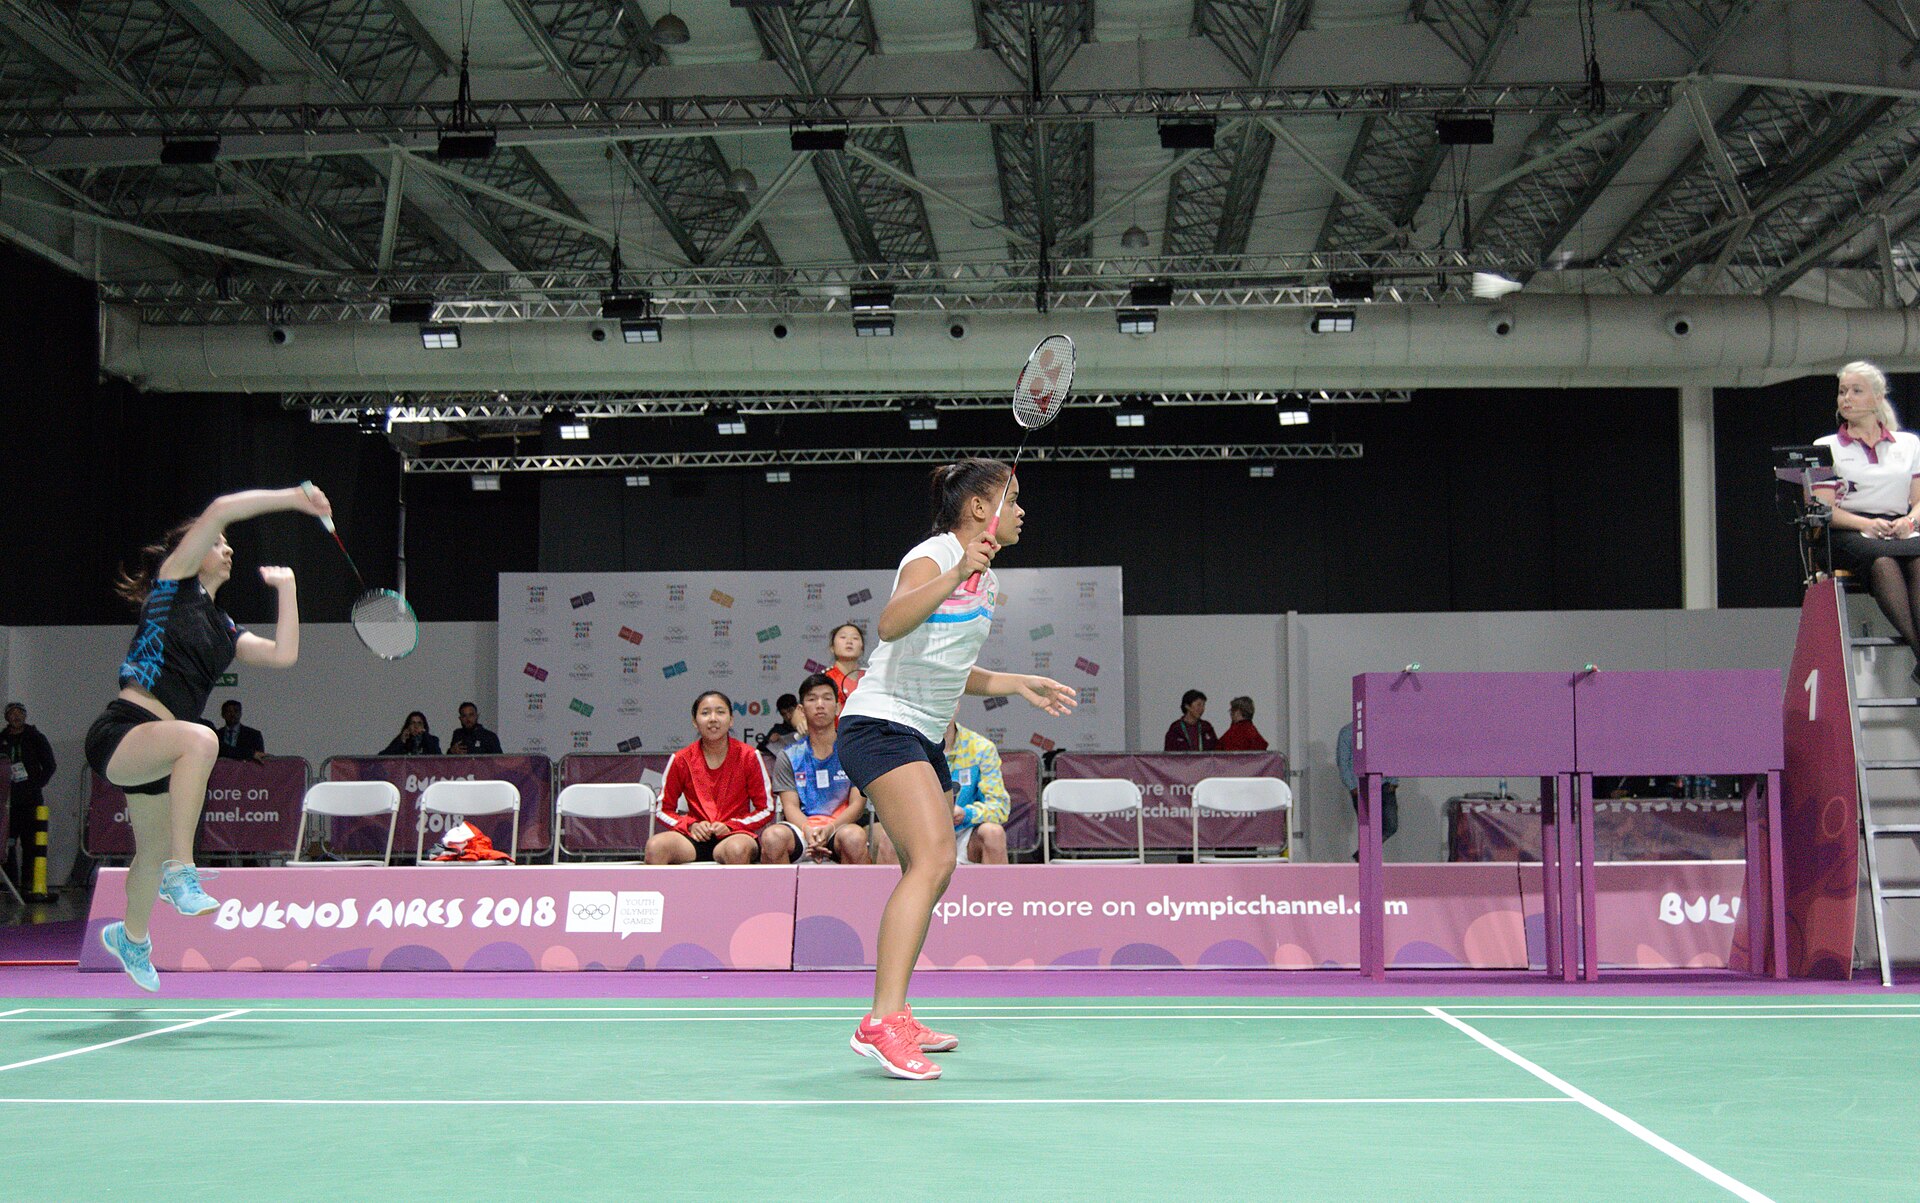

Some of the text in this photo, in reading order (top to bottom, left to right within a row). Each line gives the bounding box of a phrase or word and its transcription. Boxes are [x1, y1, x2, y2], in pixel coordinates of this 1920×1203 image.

[1804, 669, 1819, 721] 1
[733, 699, 771, 717] NOS
[208, 788, 269, 801] ore on
[625, 898, 656, 907] YOUTH
[932, 894, 1014, 925] xplore
[1022, 900, 1093, 917] more
[1101, 900, 1136, 917] on
[214, 895, 557, 930] BUENOS AIRES 2018
[620, 908, 659, 916] OLYMPIC
[622, 917, 654, 925] GAMES
